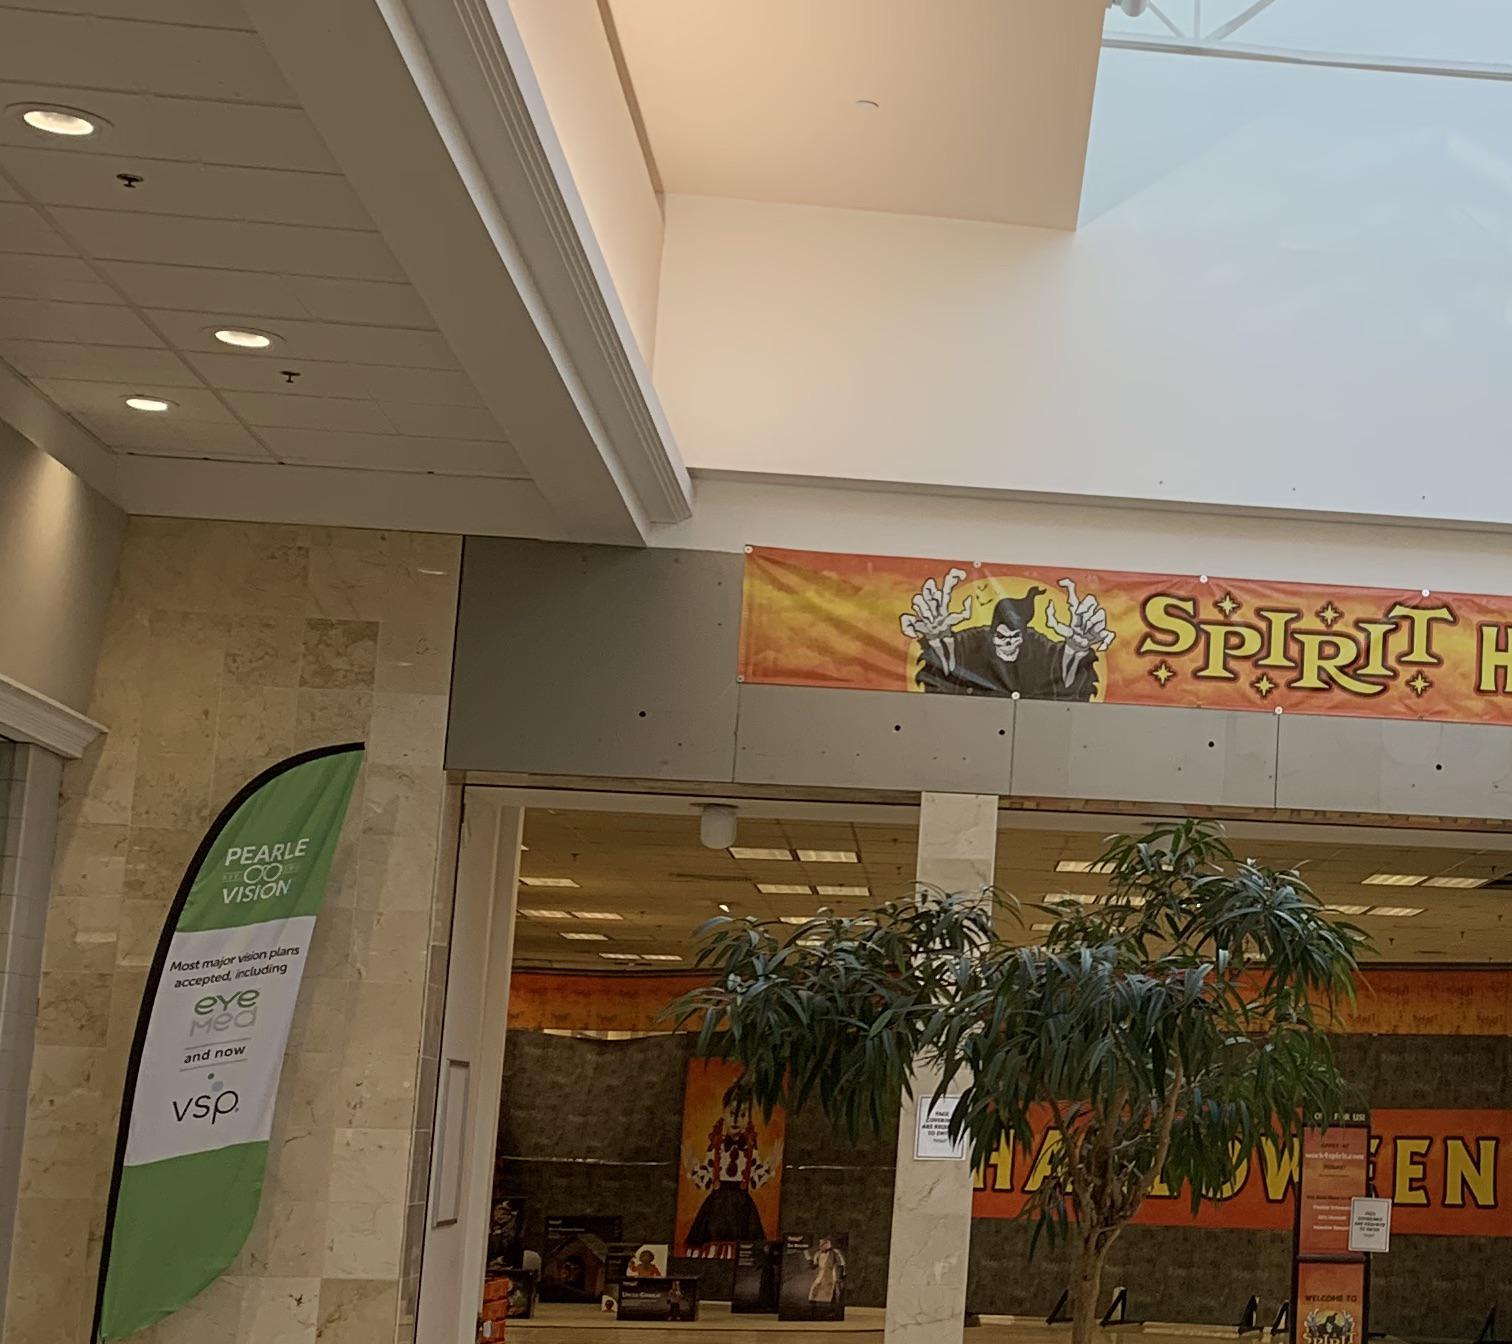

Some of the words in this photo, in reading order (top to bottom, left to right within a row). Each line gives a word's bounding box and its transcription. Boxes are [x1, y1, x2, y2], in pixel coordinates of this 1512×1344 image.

[1137, 594, 1457, 696] SPIRIT
[225, 838, 310, 866] PEARLE
[222, 879, 292, 904] VISION
[169, 960, 200, 972] Most
[202, 955, 236, 970] major
[238, 950, 268, 963] vision
[269, 946, 300, 960] plans
[174, 971, 232, 988] accepted,
[235, 963, 288, 979] including
[184, 1049, 211, 1064] and
[214, 1045, 246, 1059] now
